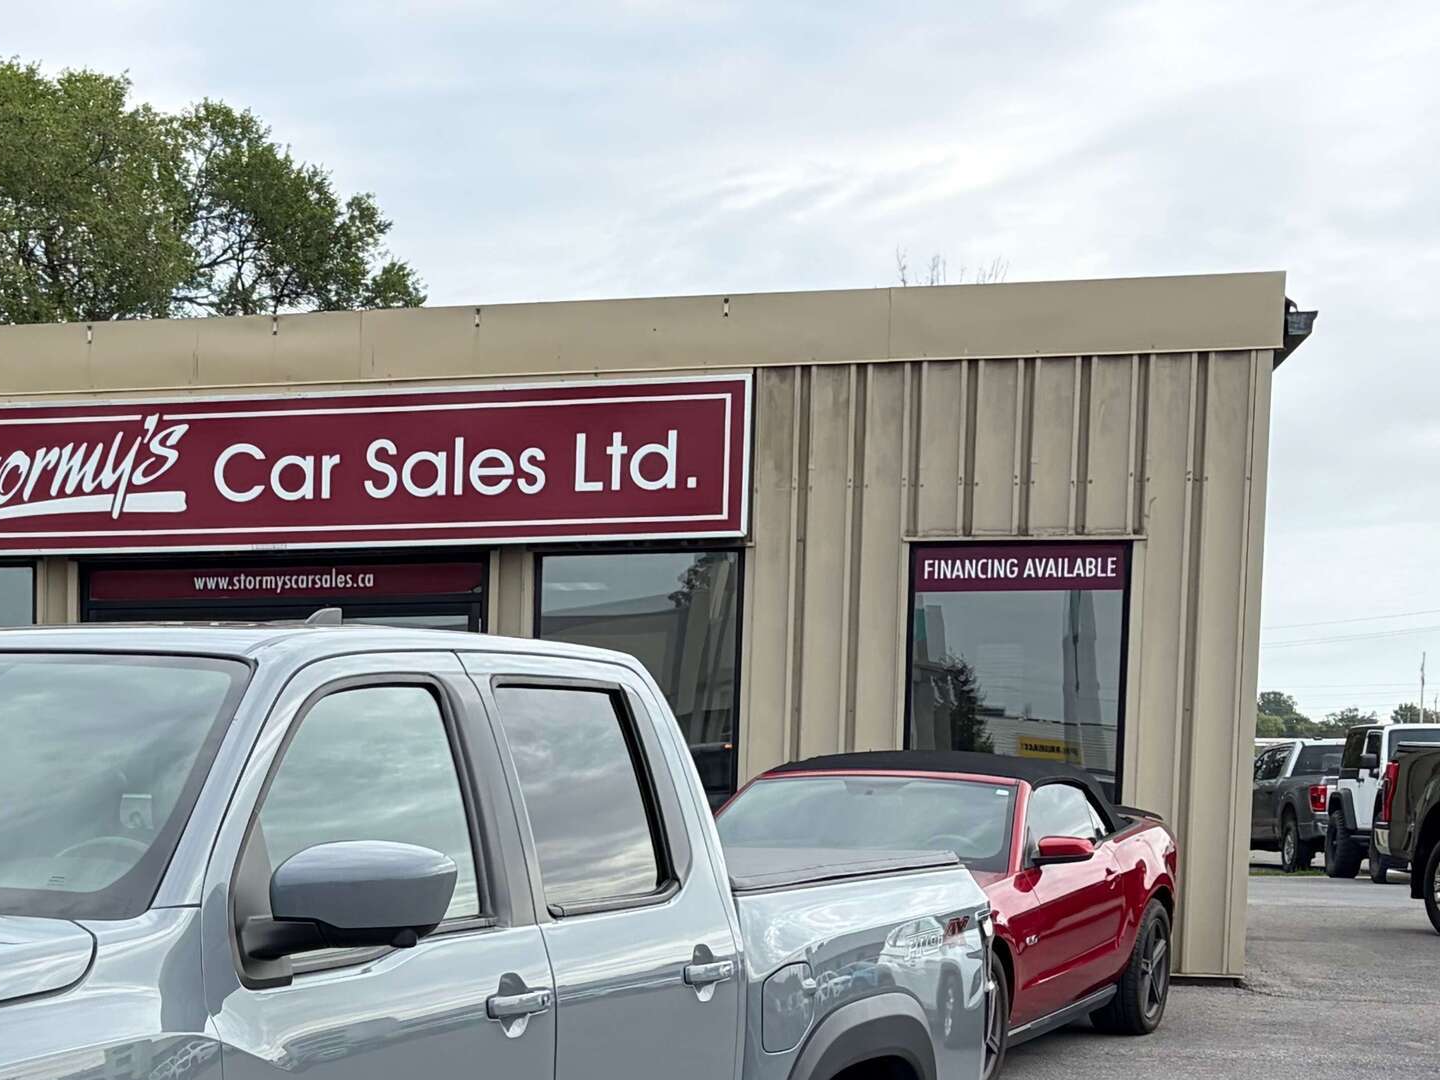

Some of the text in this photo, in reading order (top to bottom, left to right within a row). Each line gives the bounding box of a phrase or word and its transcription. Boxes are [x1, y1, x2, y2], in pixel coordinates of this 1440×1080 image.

[213, 443, 341, 503] Car
[364, 436, 546, 499] Sales
[574, 429, 697, 492] Ltd.
[194, 568, 374, 593] www.stormyscarsales.ca
[924, 557, 1117, 580] FINANCING AVAILABLE
